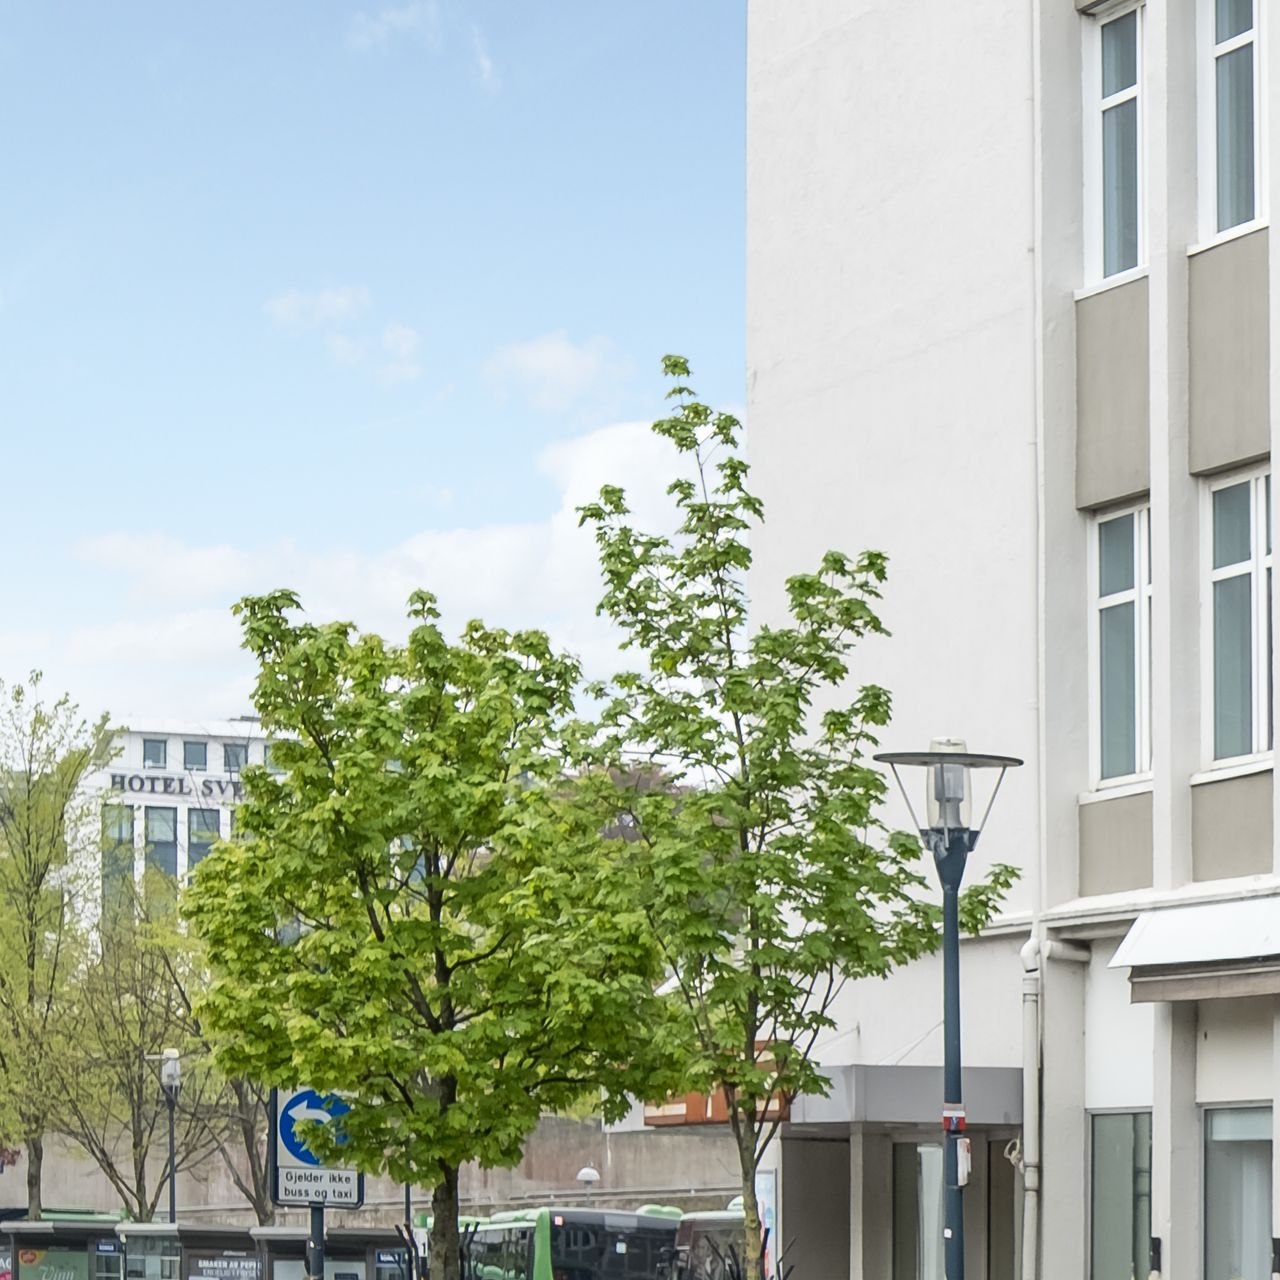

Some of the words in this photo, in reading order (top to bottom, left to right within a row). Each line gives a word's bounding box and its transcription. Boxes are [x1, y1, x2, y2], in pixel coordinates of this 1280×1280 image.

[110, 773, 192, 795] HOTEL
[285, 1171, 323, 1184] Gjelder
[329, 1173, 351, 1184] ikke
[284, 1187, 309, 1197] buss
[314, 1189, 328, 1199] og
[332, 1188, 352, 1199] taxi
